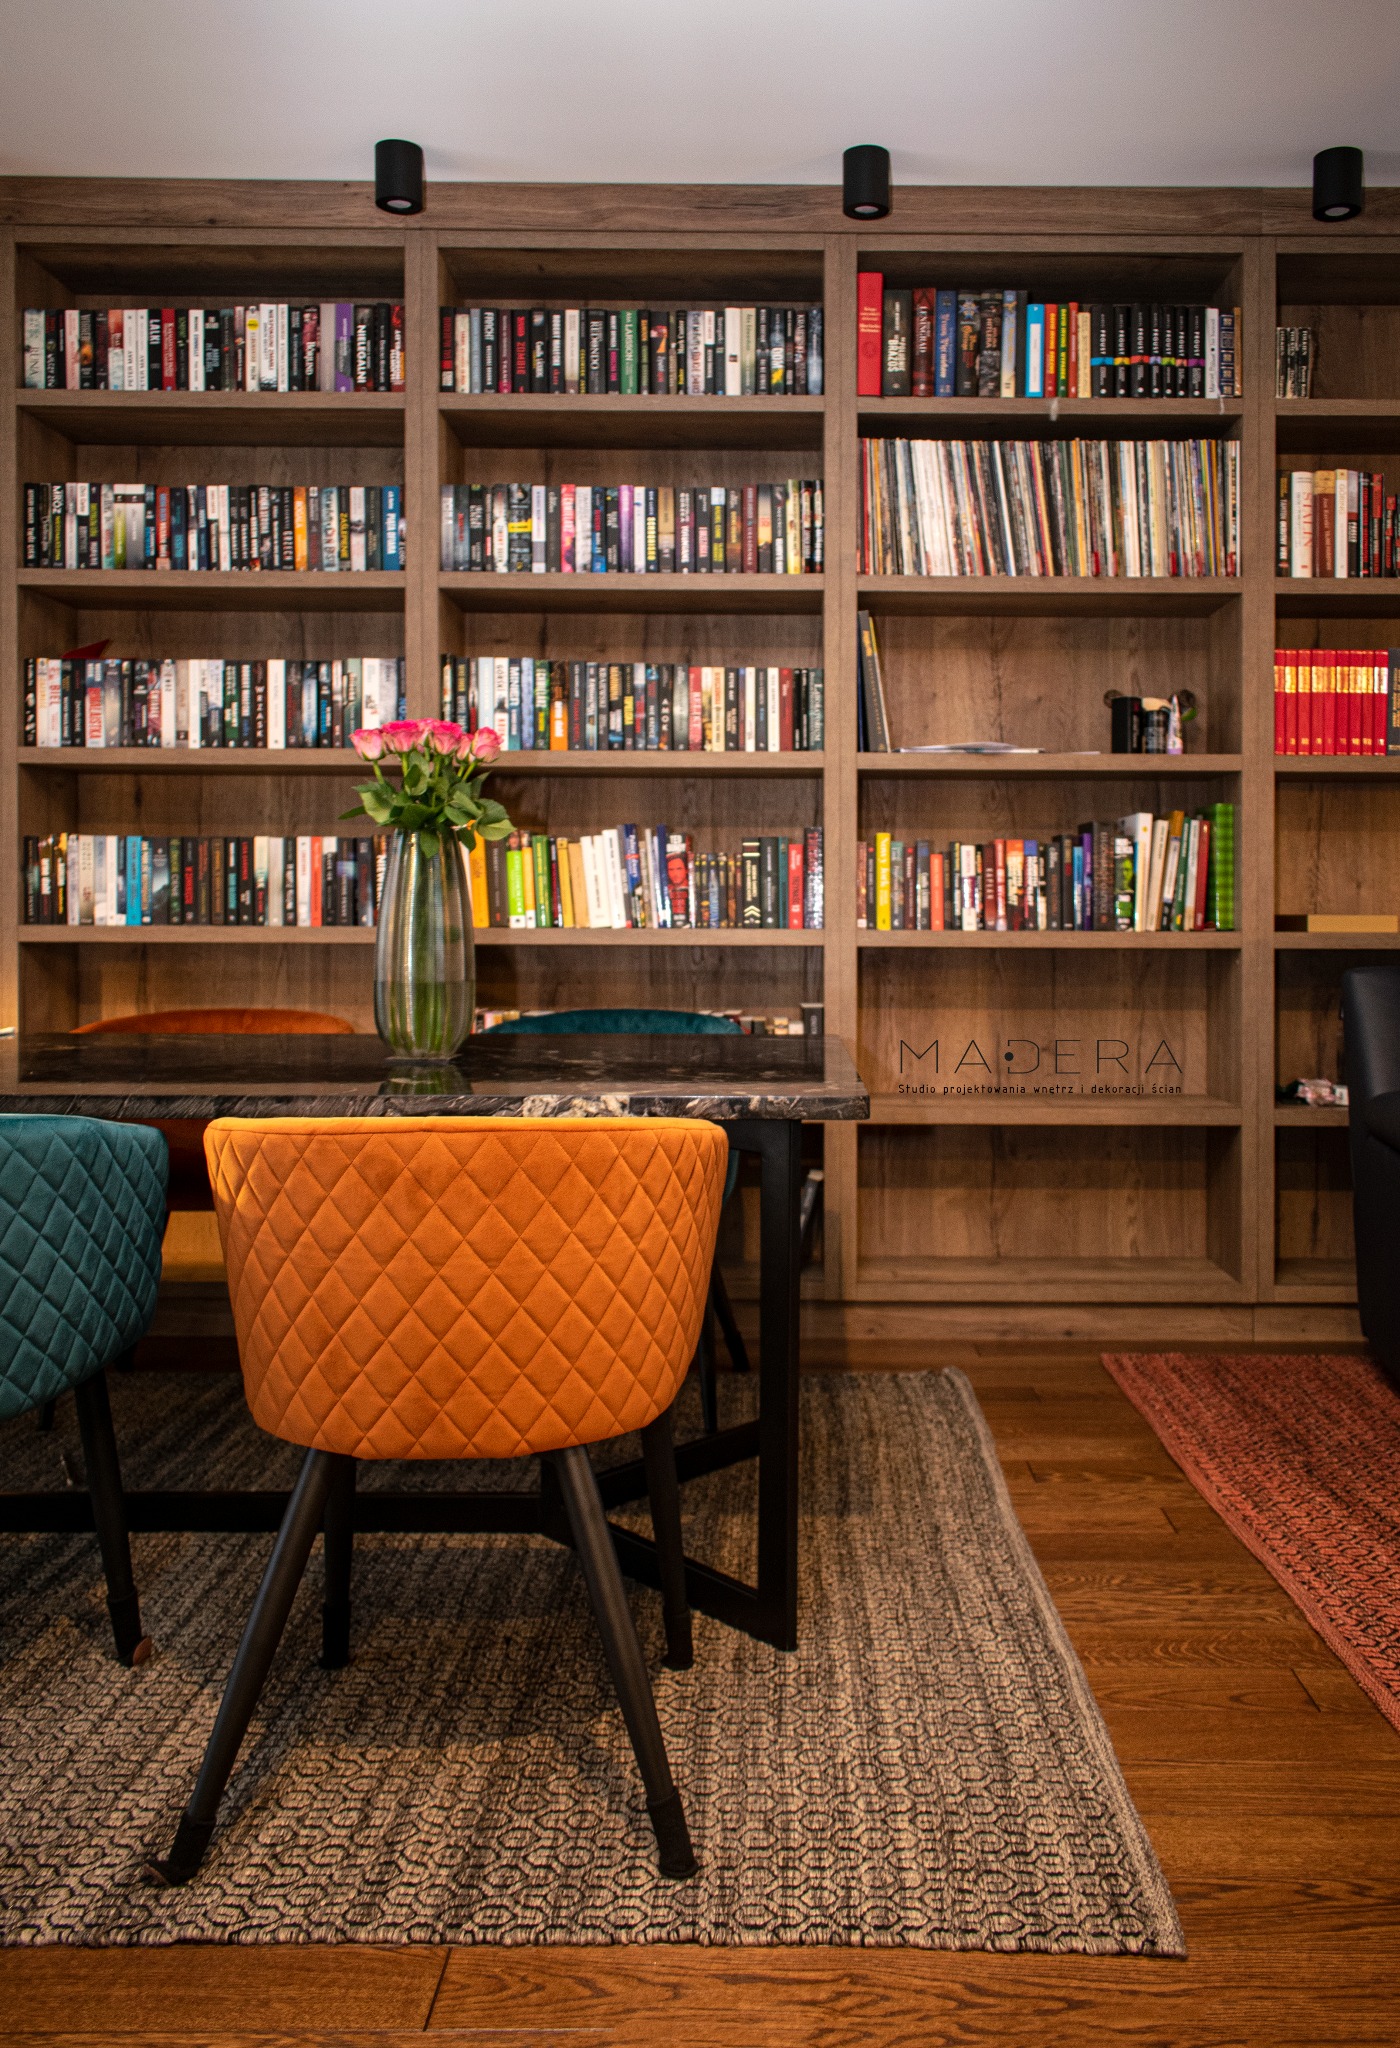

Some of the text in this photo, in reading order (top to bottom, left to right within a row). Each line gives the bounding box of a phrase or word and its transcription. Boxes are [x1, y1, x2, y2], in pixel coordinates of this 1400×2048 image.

[149, 319, 161, 345] LALKI
[356, 324, 367, 384] NIELEGALNI
[770, 347, 785, 369] DOM
[887, 339, 899, 372] BRAZOS
[1302, 492, 1313, 548] STALIN
